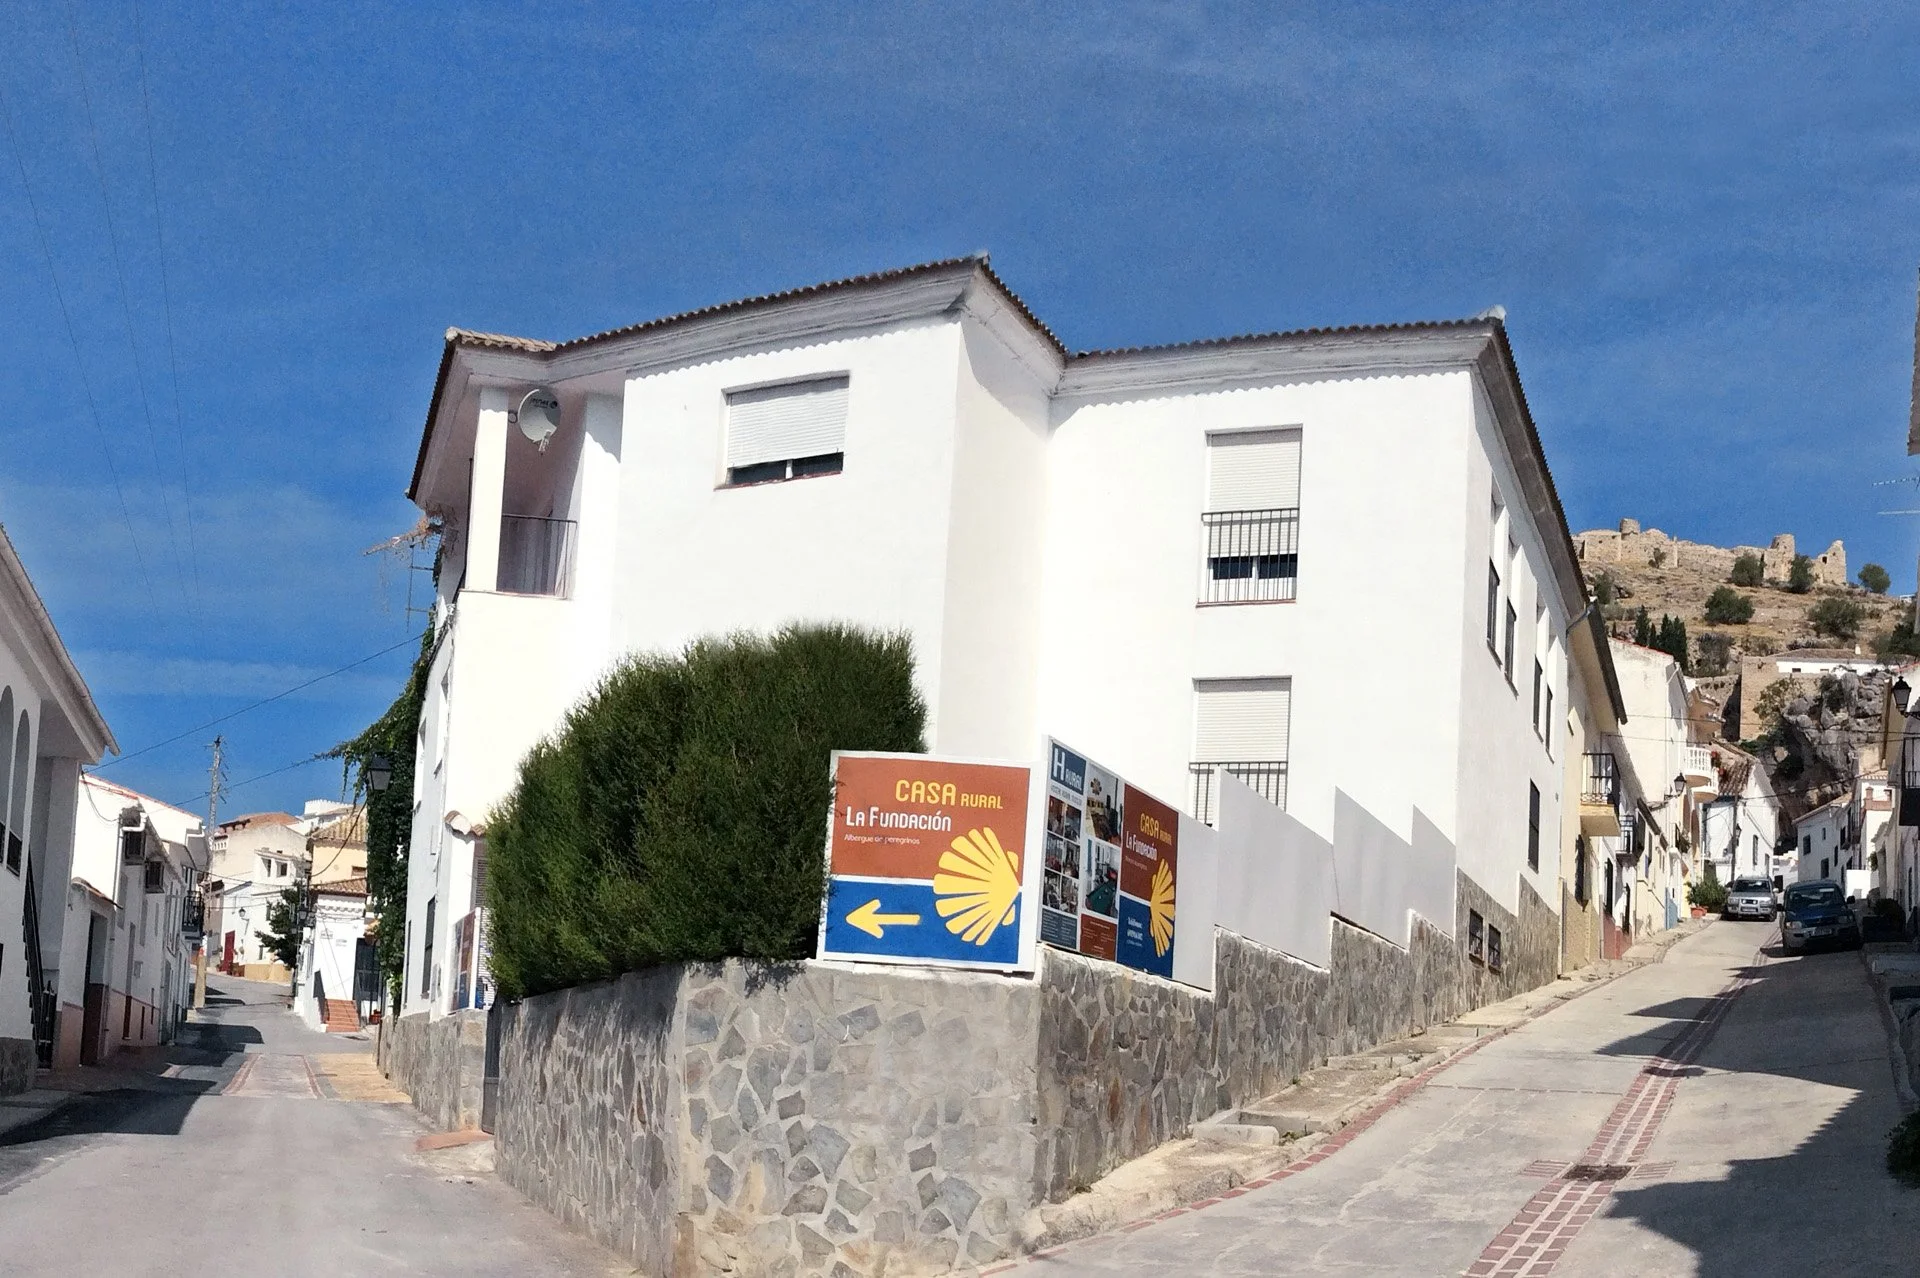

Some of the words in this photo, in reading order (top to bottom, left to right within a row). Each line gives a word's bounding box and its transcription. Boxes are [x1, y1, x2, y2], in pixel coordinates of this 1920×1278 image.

[1053, 747, 1066, 781] H
[895, 779, 956, 806] CASA
[960, 793, 1003, 809] RURAL
[843, 833, 874, 844] Albergue
[884, 836, 920, 845] peregrinos
[1140, 812, 1160, 840] CASA
